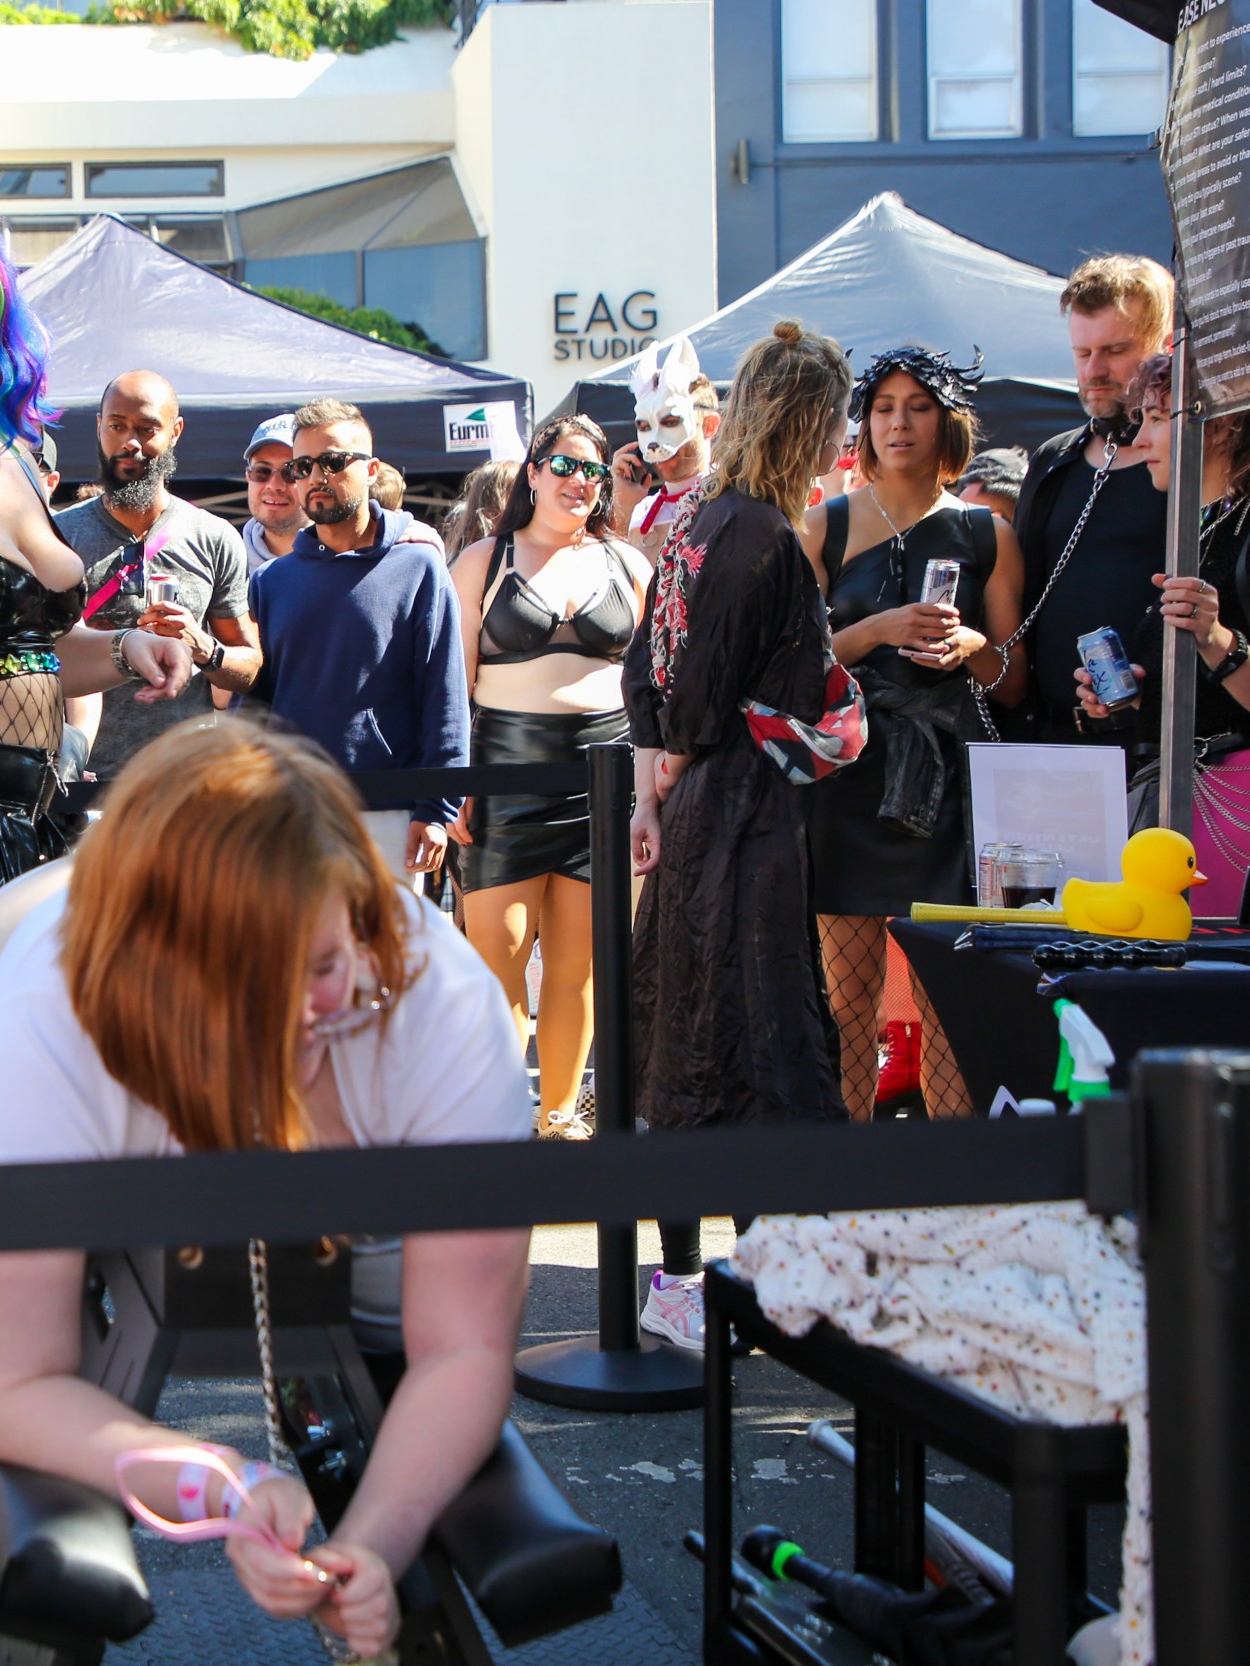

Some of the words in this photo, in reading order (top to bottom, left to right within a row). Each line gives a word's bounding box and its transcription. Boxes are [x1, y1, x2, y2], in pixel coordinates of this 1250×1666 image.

[1209, 39, 1216, 49] to
[1216, 24, 1250, 45] experience
[1197, 57, 1216, 75] scene?
[1197, 81, 1208, 97] soft
[1211, 73, 1225, 90] hard
[1225, 64, 1247, 83] limits?
[1201, 95, 1224, 114] medical
[1200, 117, 1220, 136] status?
[1220, 111, 1239, 127] When
[1239, 107, 1250, 119] was
[1198, 143, 1211, 156] What
[1211, 140, 1221, 151] are
[1220, 135, 1234, 150] your
[1234, 127, 1250, 142] safer
[1197, 165, 1210, 178] areas
[1210, 162, 1217, 172] to
[1216, 153, 1232, 170] avoid
[1231, 153, 1239, 164] or
[1193, 191, 1202, 203] you
[1201, 180, 1222, 199] typically
[1222, 171, 1242, 188] scene?
[1190, 212, 1200, 225] your
[1199, 207, 1208, 219] last
[1208, 199, 1225, 216] scene?
[1217, 216, 1236, 233] needs?
[1203, 246, 1220, 261] triggers
[1219, 243, 1226, 253] or
[1225, 238, 1237, 253] past
[1219, 279, 1240, 297] especially
[1240, 278, 1250, 289] use
[554, 289, 658, 334] EAG
[1219, 303, 1232, 318] marks
[449, 422, 489, 441] Eurm
